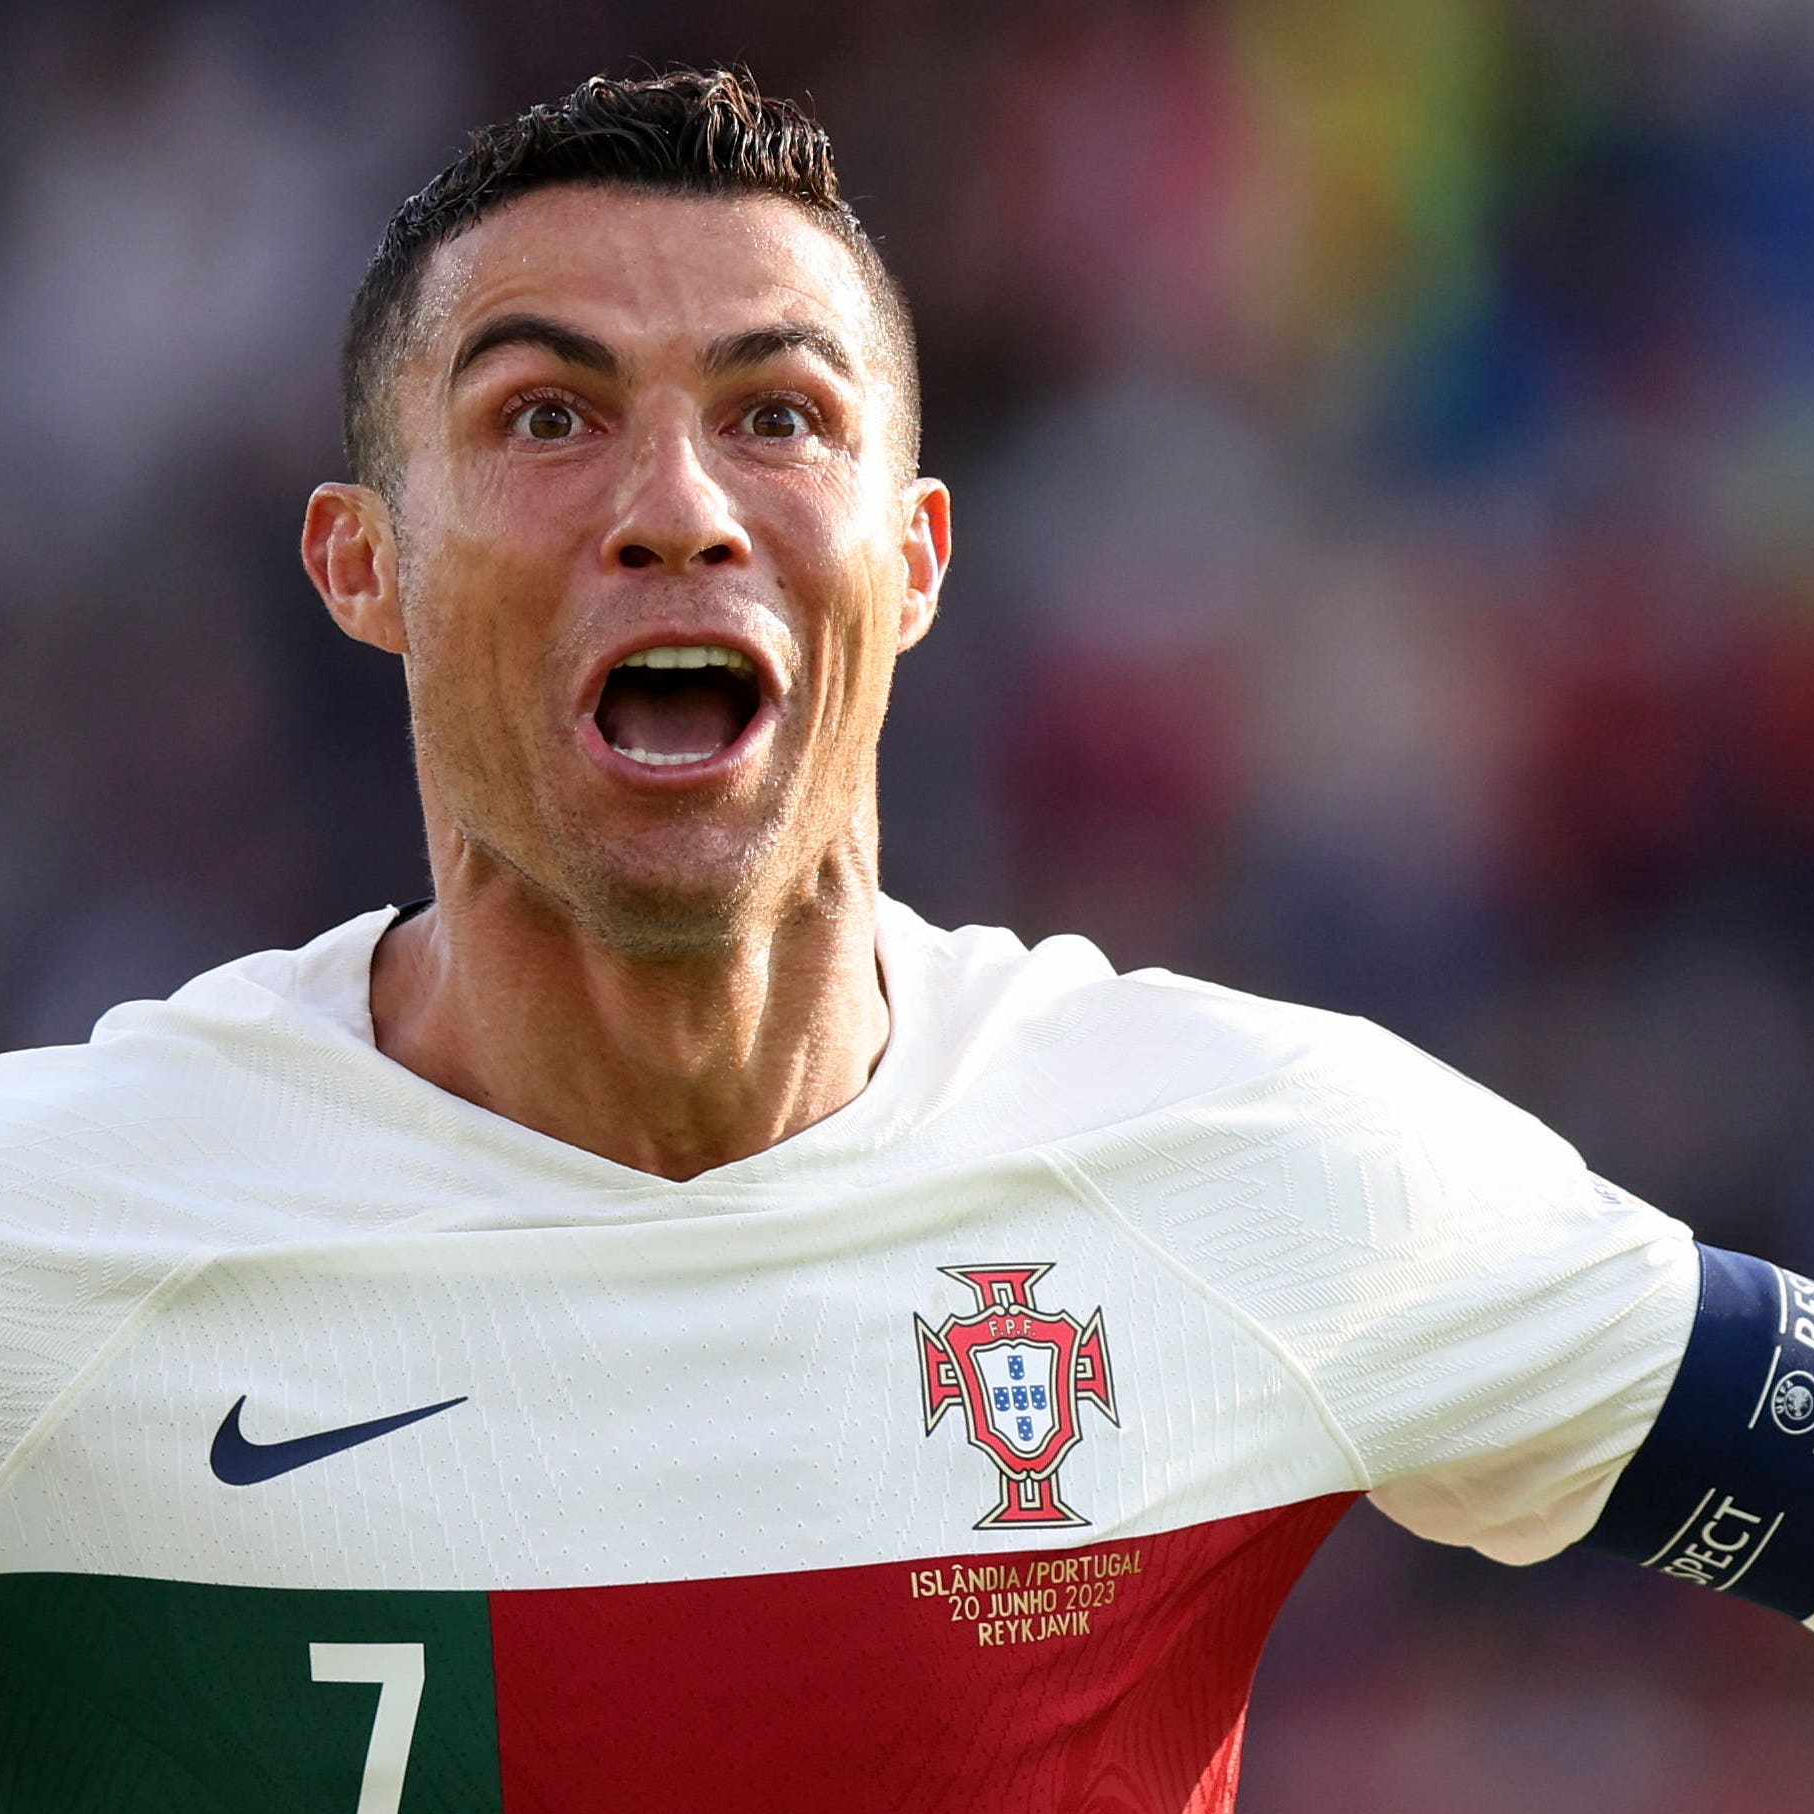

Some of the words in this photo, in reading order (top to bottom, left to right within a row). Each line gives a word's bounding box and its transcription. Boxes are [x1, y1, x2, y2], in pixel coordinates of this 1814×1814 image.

[988, 1319, 1036, 1337] F.P.F.
[948, 1596, 980, 1621] 20
[987, 1588, 1058, 1619] JUNHO
[1065, 1580, 1116, 1610] 2023
[978, 1611, 1091, 1647] REYKJAVIK
